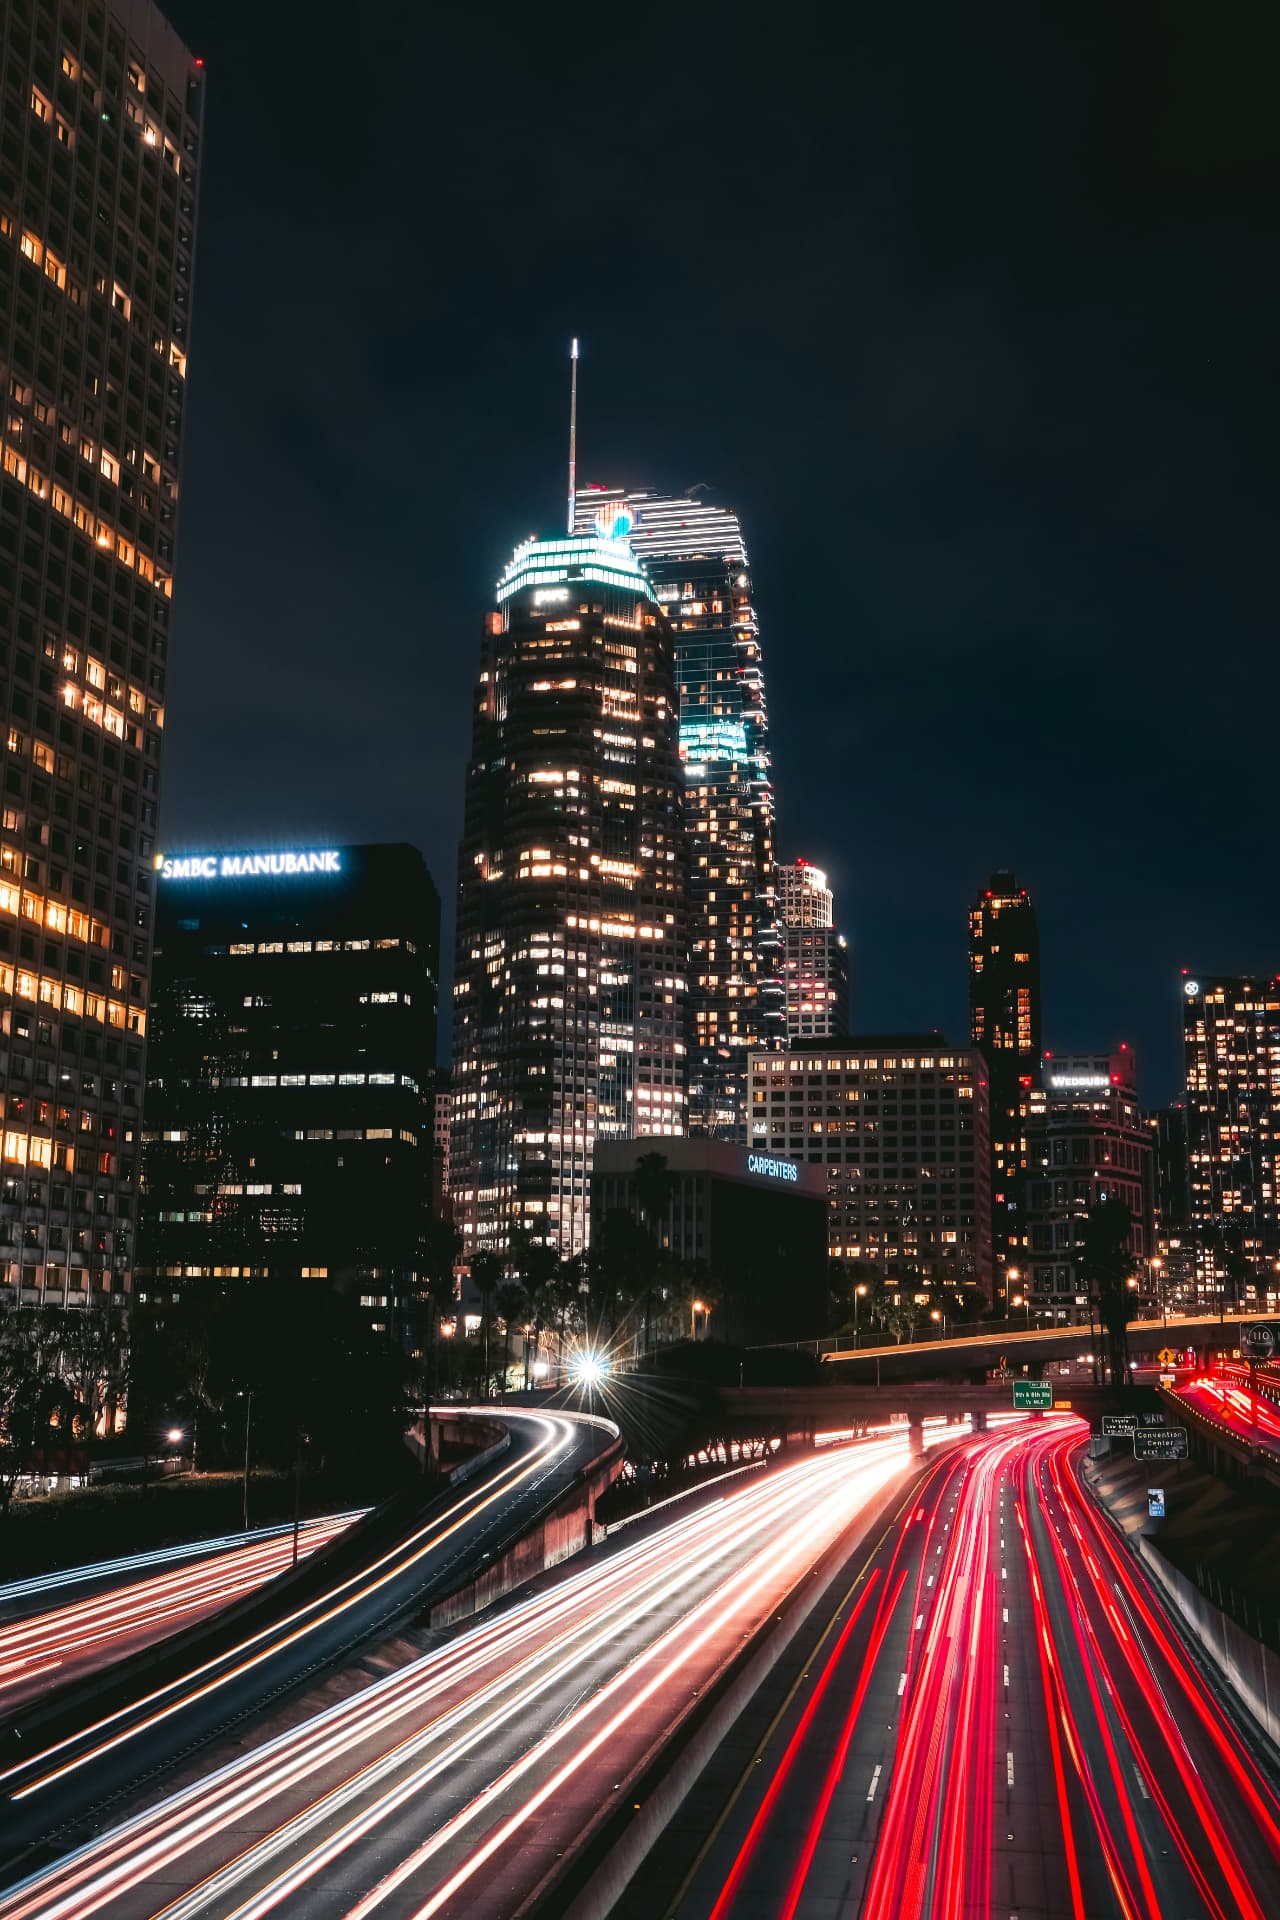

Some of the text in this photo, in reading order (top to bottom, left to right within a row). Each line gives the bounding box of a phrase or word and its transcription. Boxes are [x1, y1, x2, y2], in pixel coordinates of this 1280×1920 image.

[162, 852, 341, 878] SMBC MANUBANK
[748, 1154, 797, 1181] CARPENTERS
[1253, 1331, 1270, 1341] 110
[1137, 1431, 1183, 1439] Convention
